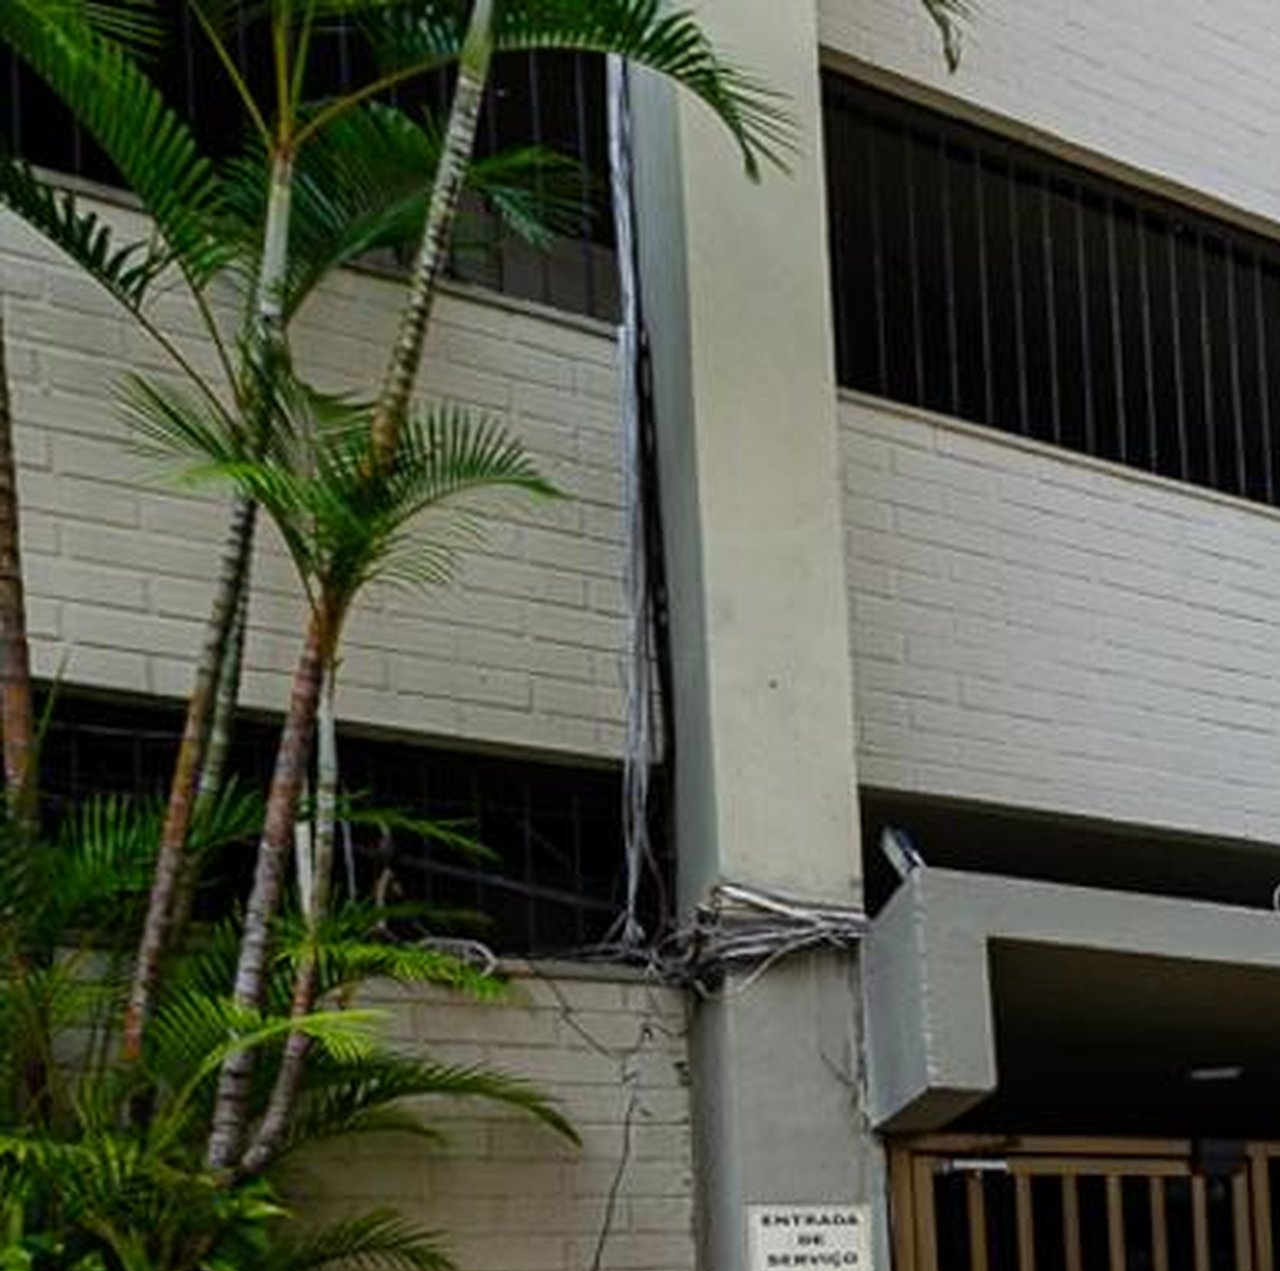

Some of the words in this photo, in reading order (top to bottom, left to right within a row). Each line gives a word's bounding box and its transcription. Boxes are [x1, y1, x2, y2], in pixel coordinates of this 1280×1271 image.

[761, 1213, 859, 1226] ENTRADA
[798, 1235, 824, 1246] DE
[767, 1251, 859, 1268] SERVIÇO
